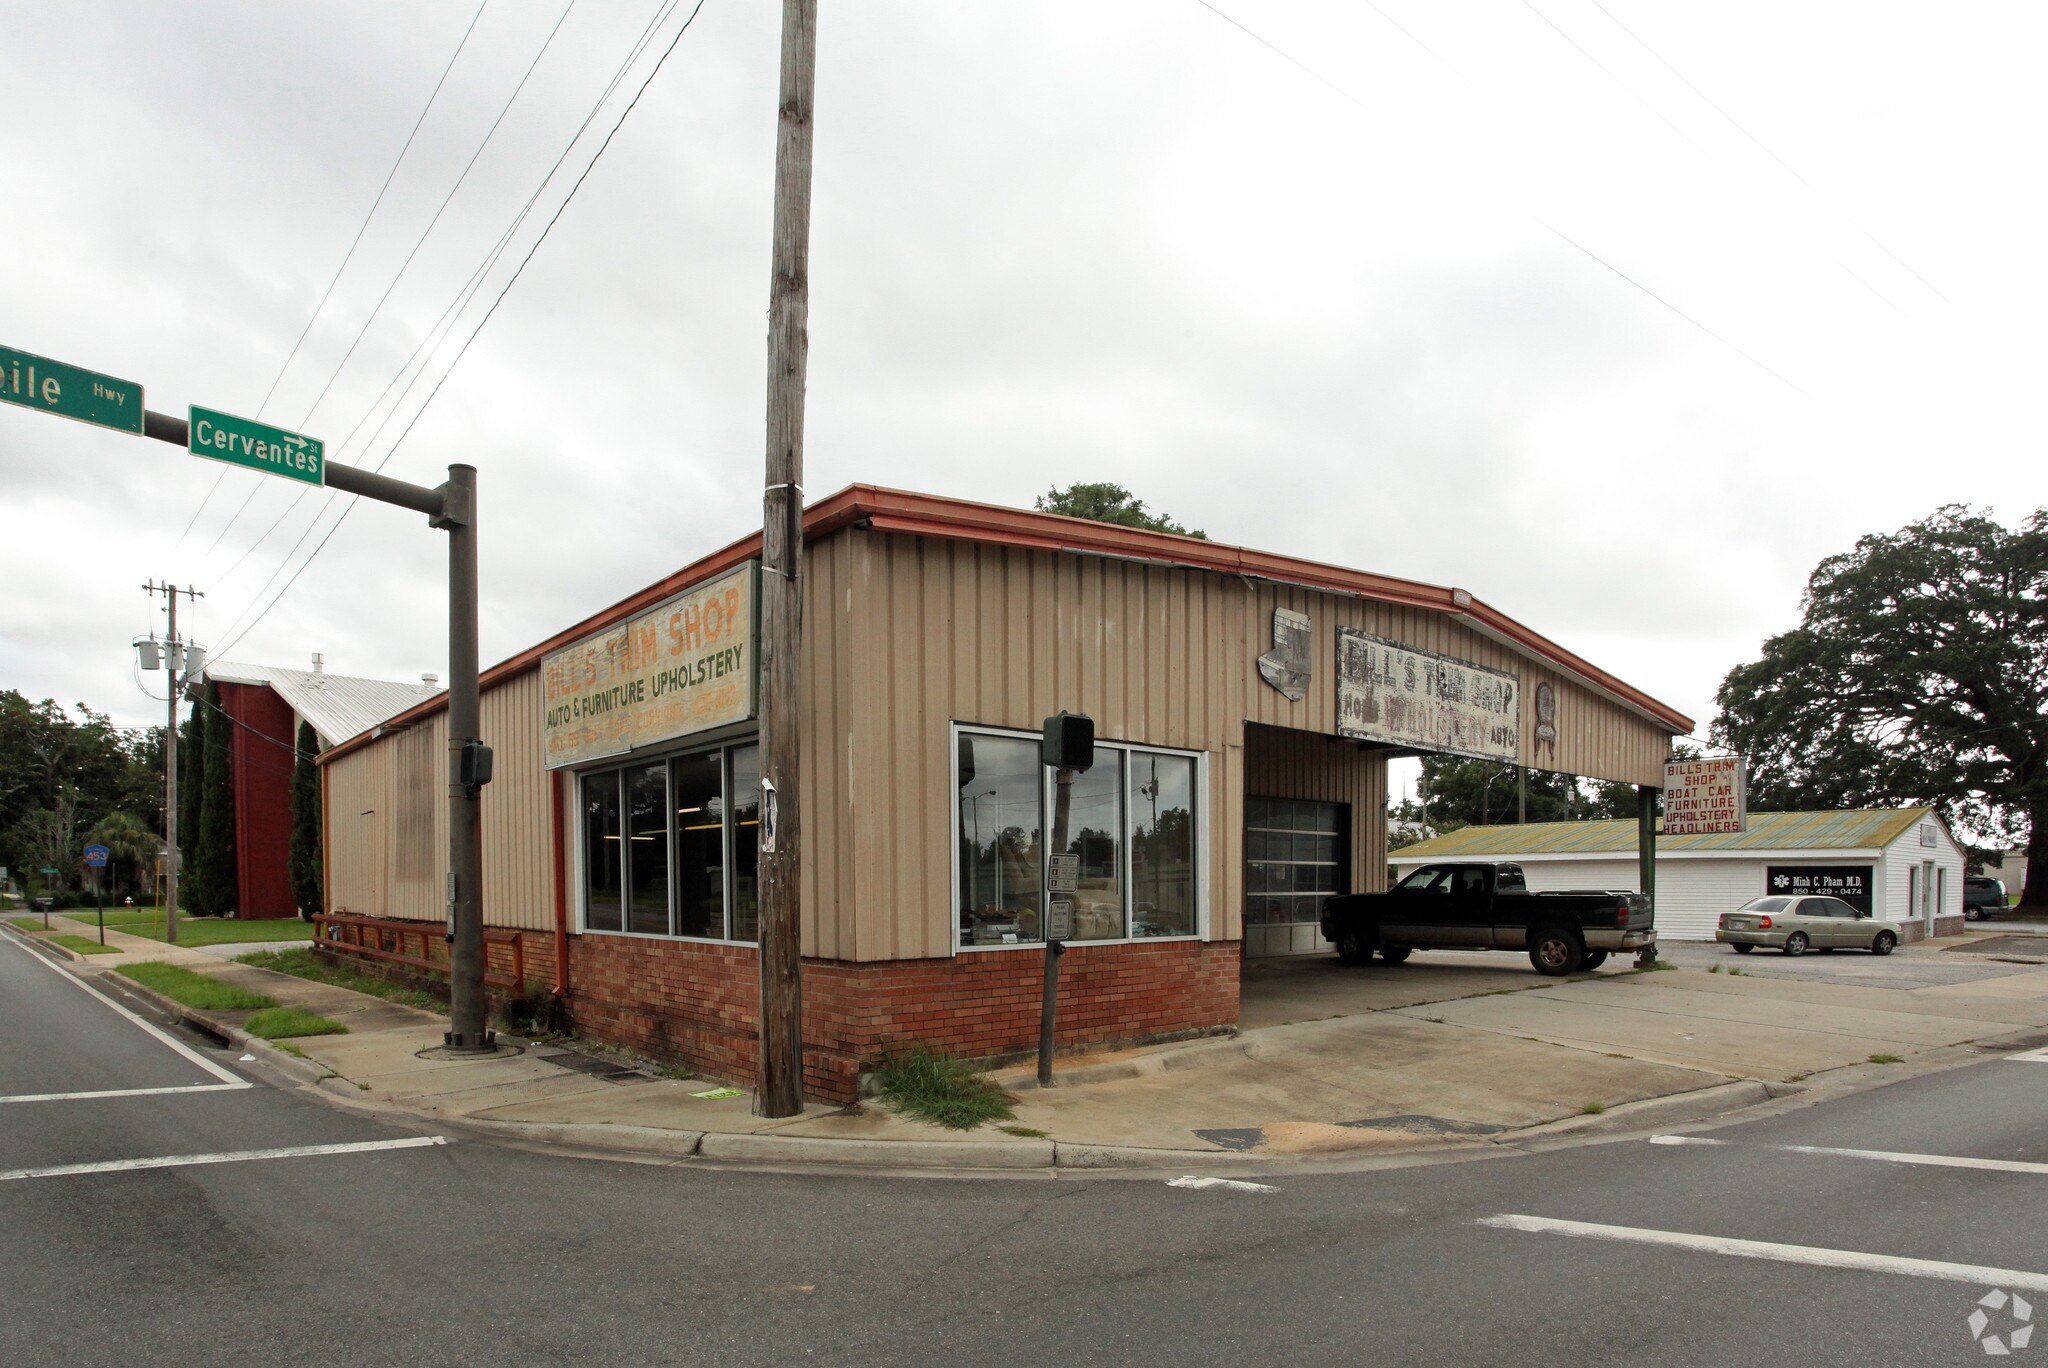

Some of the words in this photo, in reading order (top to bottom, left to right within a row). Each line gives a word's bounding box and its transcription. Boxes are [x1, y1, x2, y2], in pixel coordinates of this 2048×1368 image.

[94, 382, 125, 407] Hwy
[196, 420, 318, 473] Cervantes
[309, 443, 318, 453] St
[670, 588, 739, 656] SHOP
[547, 704, 571, 730] AUTO
[573, 697, 580, 717] &
[582, 679, 644, 718] FURNITURE
[652, 643, 743, 697] UPHOLSTERY
[1471, 674, 1513, 714] SHOP
[1668, 763, 1702, 776] BILL'S
[1706, 761, 1735, 772] TRIM
[1685, 774, 1716, 786] SHOP
[1668, 787, 1698, 799] BOAT
[1708, 785, 1732, 797] CAR
[1667, 797, 1735, 811] FURNITURE
[1666, 809, 1735, 822] UPHOLSTERY
[1663, 821, 1739, 834] HEADLINERS
[86, 852, 108, 860] 453
[1793, 876, 1810, 887] Minh
[1813, 876, 1820, 887] C.
[1823, 876, 1843, 887] Pham
[1846, 876, 1862, 887] M.D.
